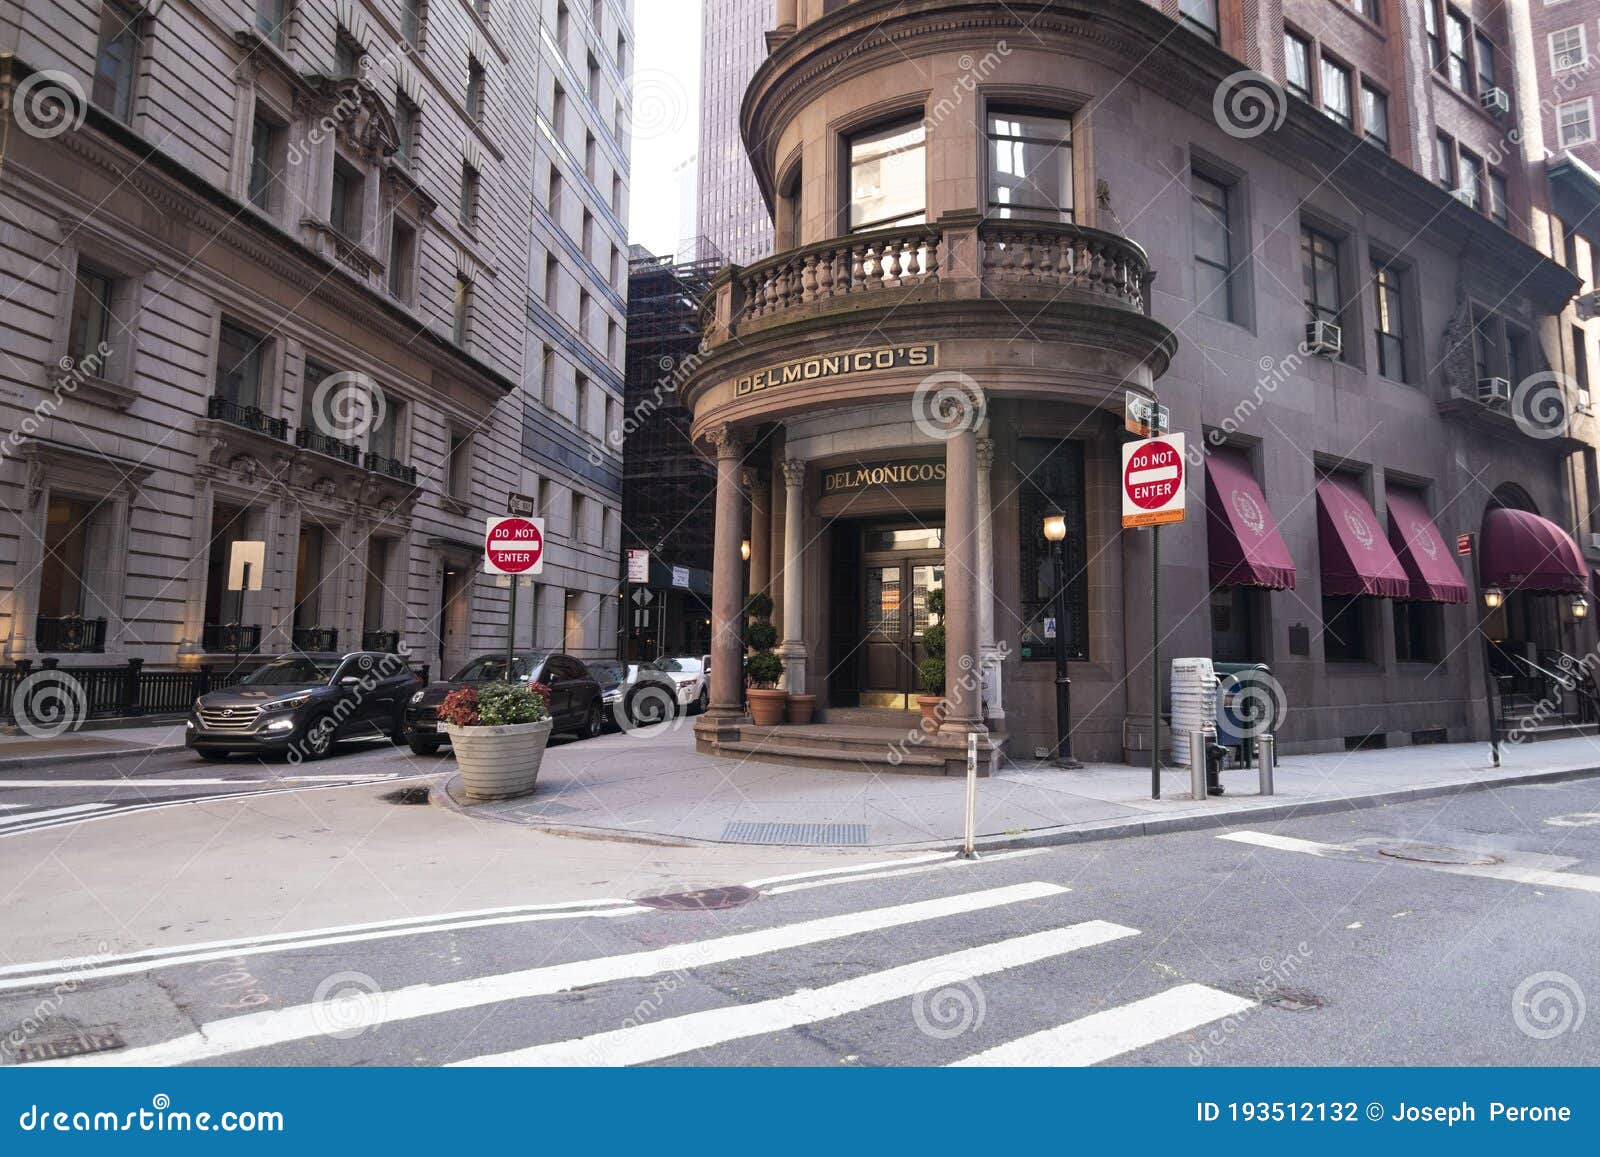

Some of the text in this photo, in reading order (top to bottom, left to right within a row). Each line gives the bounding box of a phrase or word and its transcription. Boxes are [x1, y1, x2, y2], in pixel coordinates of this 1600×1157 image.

[737, 346, 928, 395] DELMONICO'S
[1133, 450, 1173, 469] DO NOT
[825, 463, 946, 491] DELMONICOS
[1134, 482, 1172, 499] ENTER
[495, 528, 535, 538] DO NOT
[498, 553, 530, 562] ENTER
[1046, 620, 1056, 633] A
